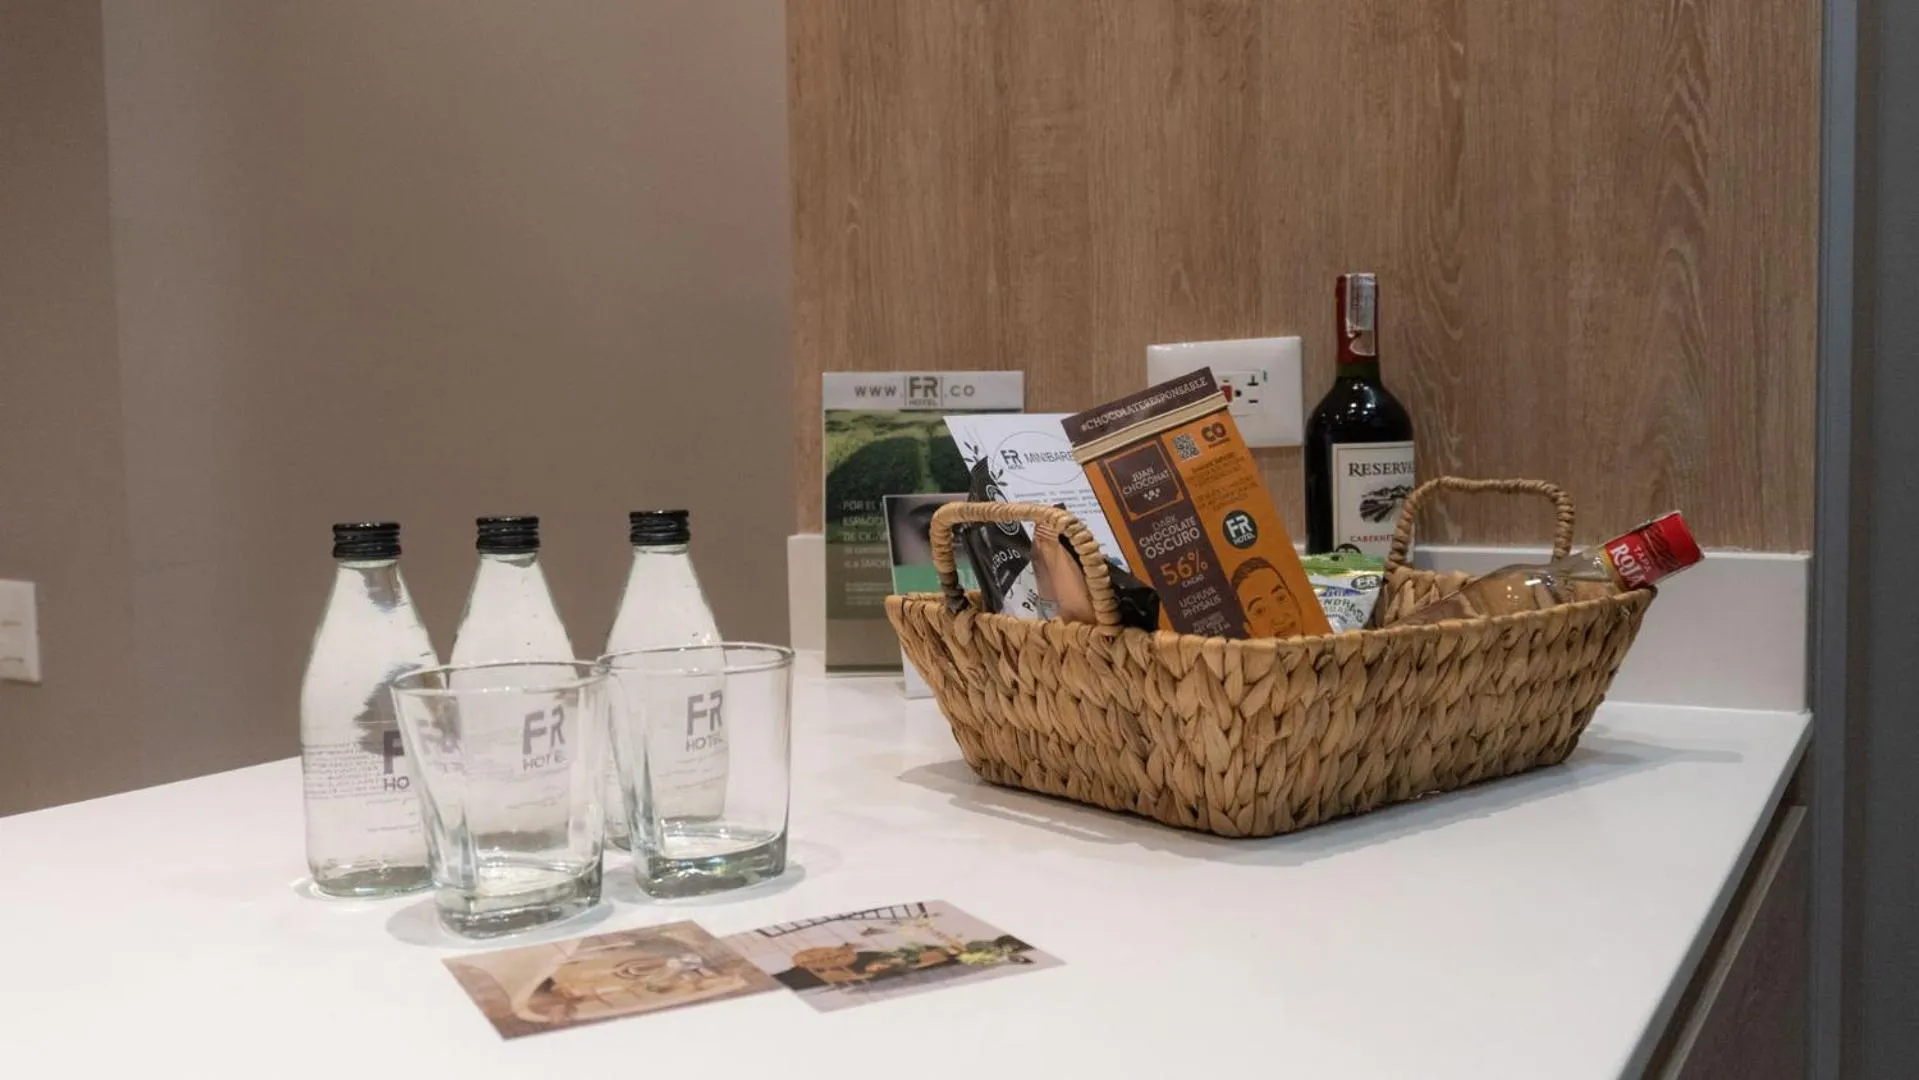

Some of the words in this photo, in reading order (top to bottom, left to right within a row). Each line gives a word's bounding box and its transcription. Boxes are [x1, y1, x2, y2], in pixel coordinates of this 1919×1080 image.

[908, 375, 939, 398] FR
[1122, 469, 1170, 495] CHOCONAT
[1131, 466, 1155, 482] JUAN
[1139, 516, 1197, 548] CHOCOLATE
[1152, 514, 1176, 531] DARK
[1225, 515, 1253, 538] FR
[1144, 527, 1200, 559] OSCURO
[1161, 548, 1208, 586] 56%
[686, 690, 724, 736] FR
[522, 705, 566, 755] FR
